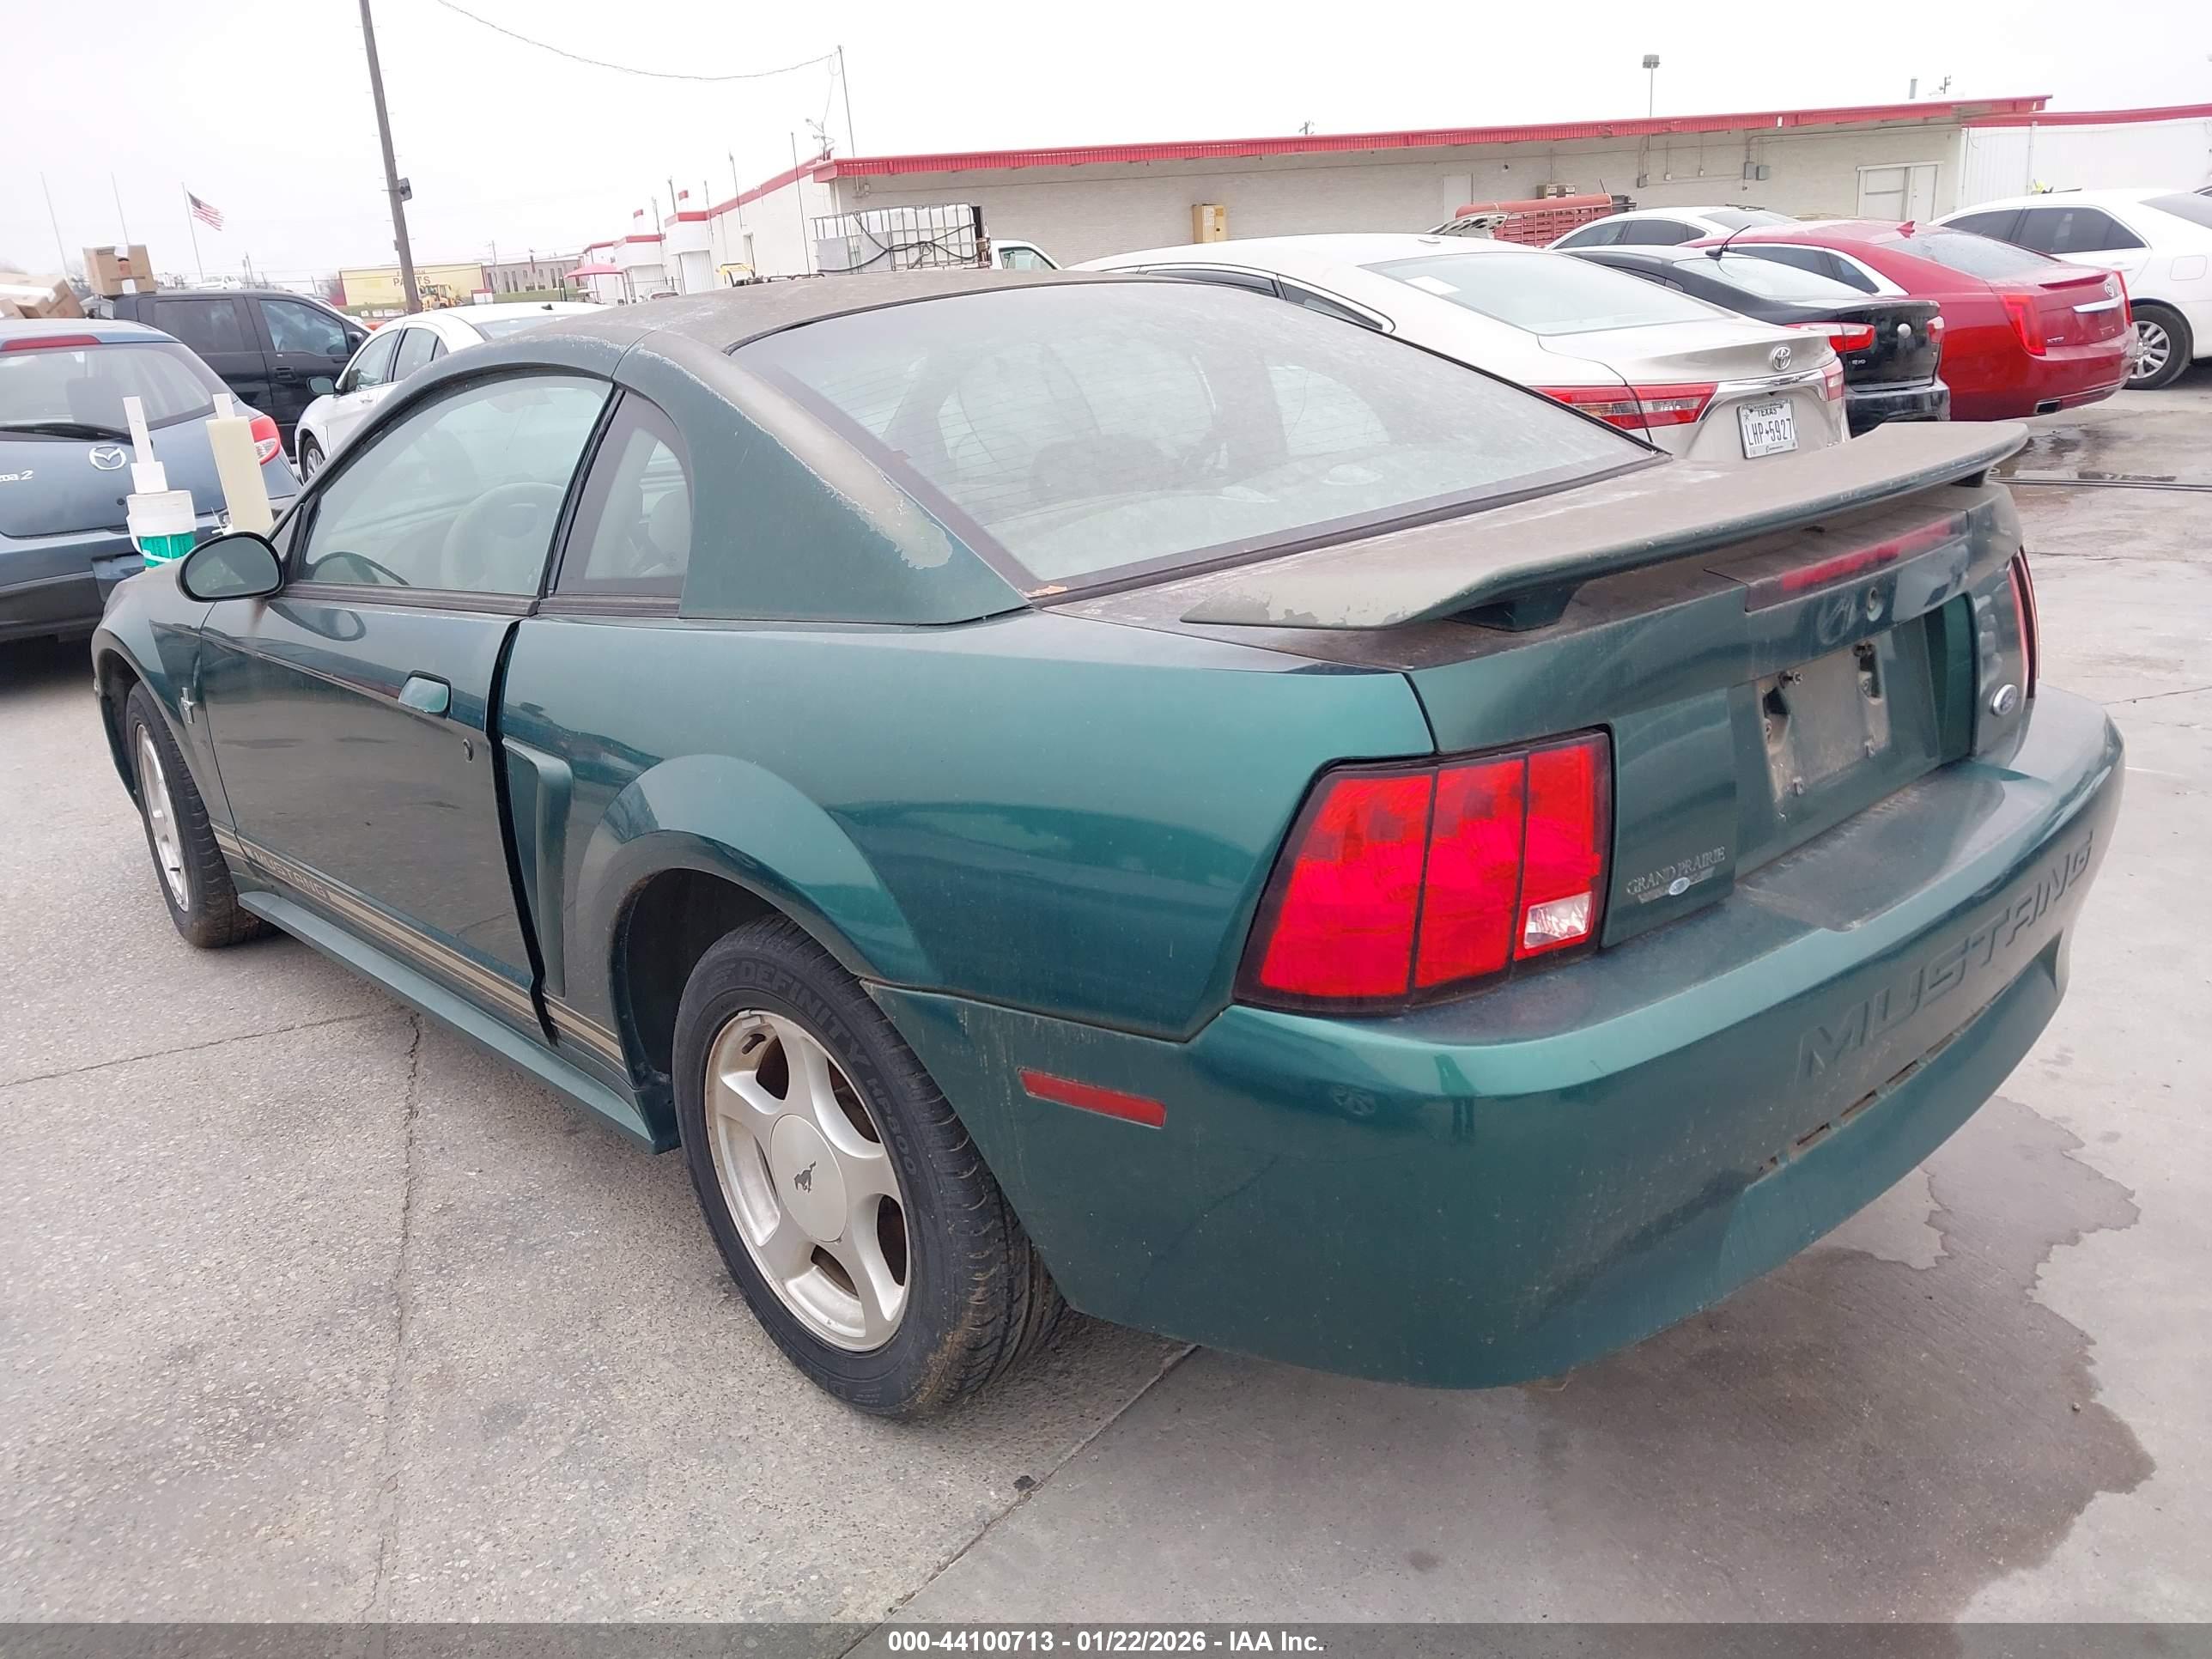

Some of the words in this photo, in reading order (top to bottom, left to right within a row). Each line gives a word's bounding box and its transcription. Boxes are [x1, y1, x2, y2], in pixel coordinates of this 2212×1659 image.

[1757, 408, 1778, 417] TEXAS
[253, 850, 328, 898] MUSTANG
[1626, 866, 1677, 895] GRAND
[1678, 846, 1725, 878] PRAIRIE
[1794, 830, 2094, 1086] MUSTANG
[740, 960, 872, 1067] DEFINITY
[866, 1077, 917, 1176] HP800
